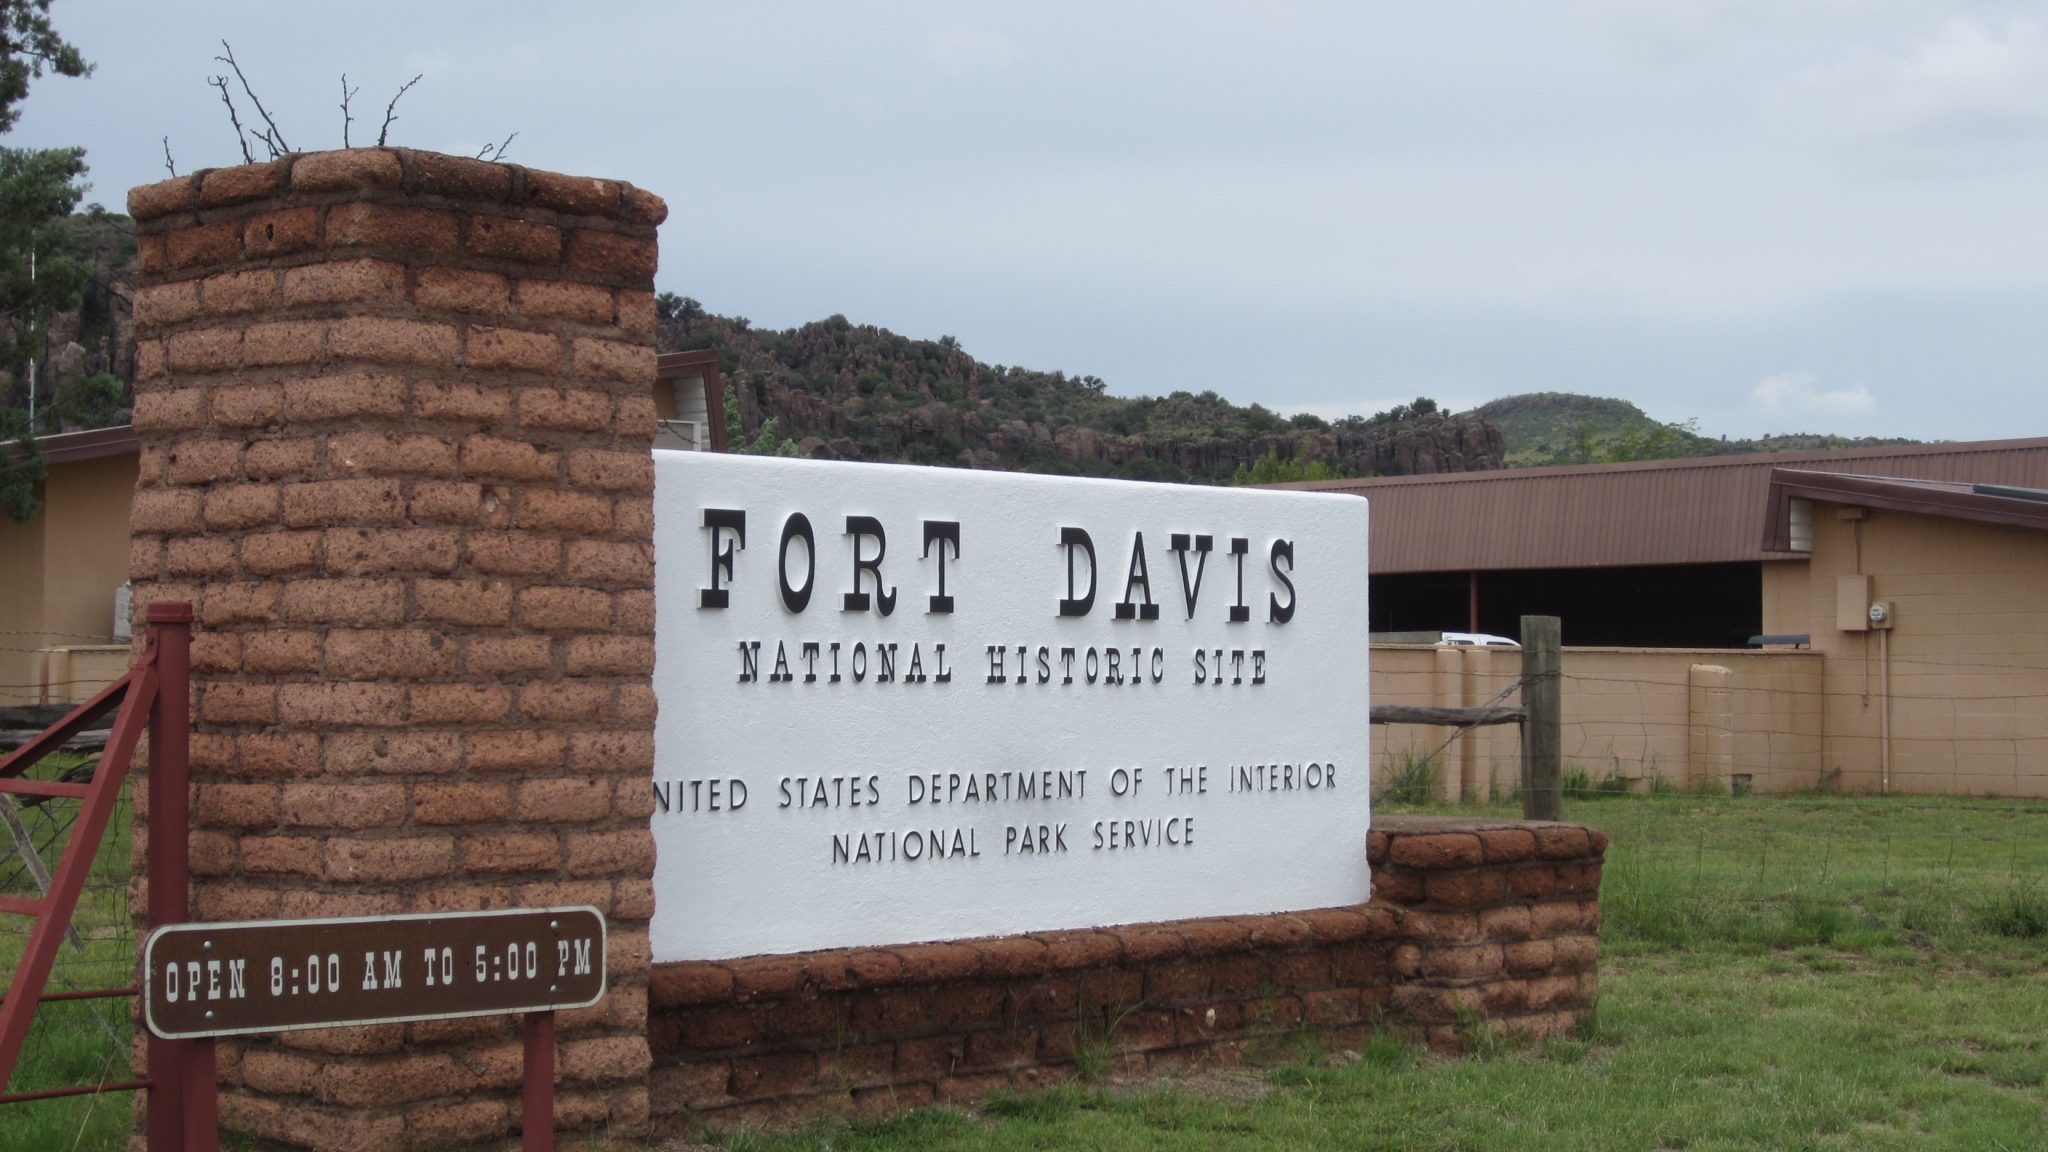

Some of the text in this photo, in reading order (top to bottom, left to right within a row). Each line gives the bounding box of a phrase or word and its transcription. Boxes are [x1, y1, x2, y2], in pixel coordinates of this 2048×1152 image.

[697, 508, 1297, 627] FORT DAVIS
[737, 640, 1267, 687] NATIONAL HISTORIC SITE
[652, 762, 1337, 814] NITED STATES DEPARTMENT OF THE INTERIOR
[832, 817, 1195, 866] NATIONAL PARK SERVICE
[165, 938, 592, 1003] OPEN 8:00 AM TO 5:00 PM
